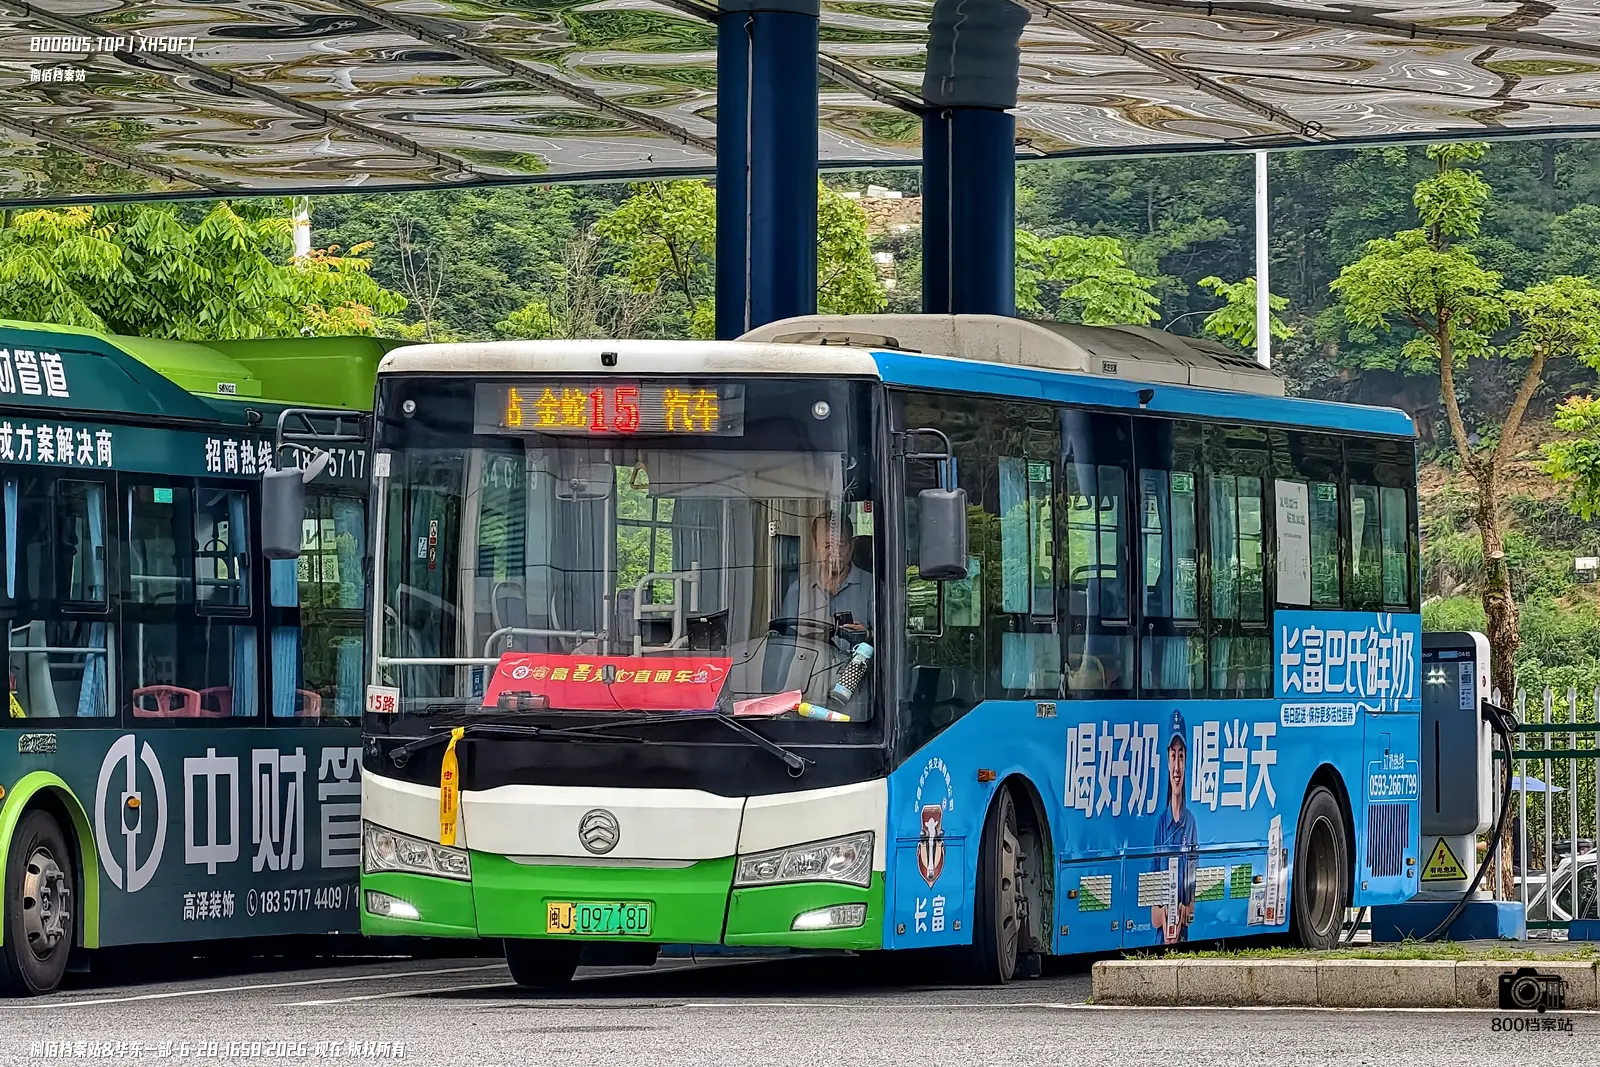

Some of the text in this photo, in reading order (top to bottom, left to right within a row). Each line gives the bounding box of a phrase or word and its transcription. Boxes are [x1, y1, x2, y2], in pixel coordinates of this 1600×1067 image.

[590, 387, 640, 431] 15
[664, 388, 718, 431] 汽车
[205, 437, 274, 475] 招商热线
[328, 448, 366, 479] 5717
[1280, 614, 1414, 713] 长富巴氏鲜奶
[369, 694, 395, 713] 15路
[1063, 719, 1277, 818] 喝好奶 喝当天
[184, 747, 362, 875] 中财管
[183, 890, 235, 921] 高泽装饰
[260, 890, 280, 913] 183
[283, 888, 311, 912] 5717
[314, 886, 342, 910] 4409
[915, 895, 946, 933] 长富
